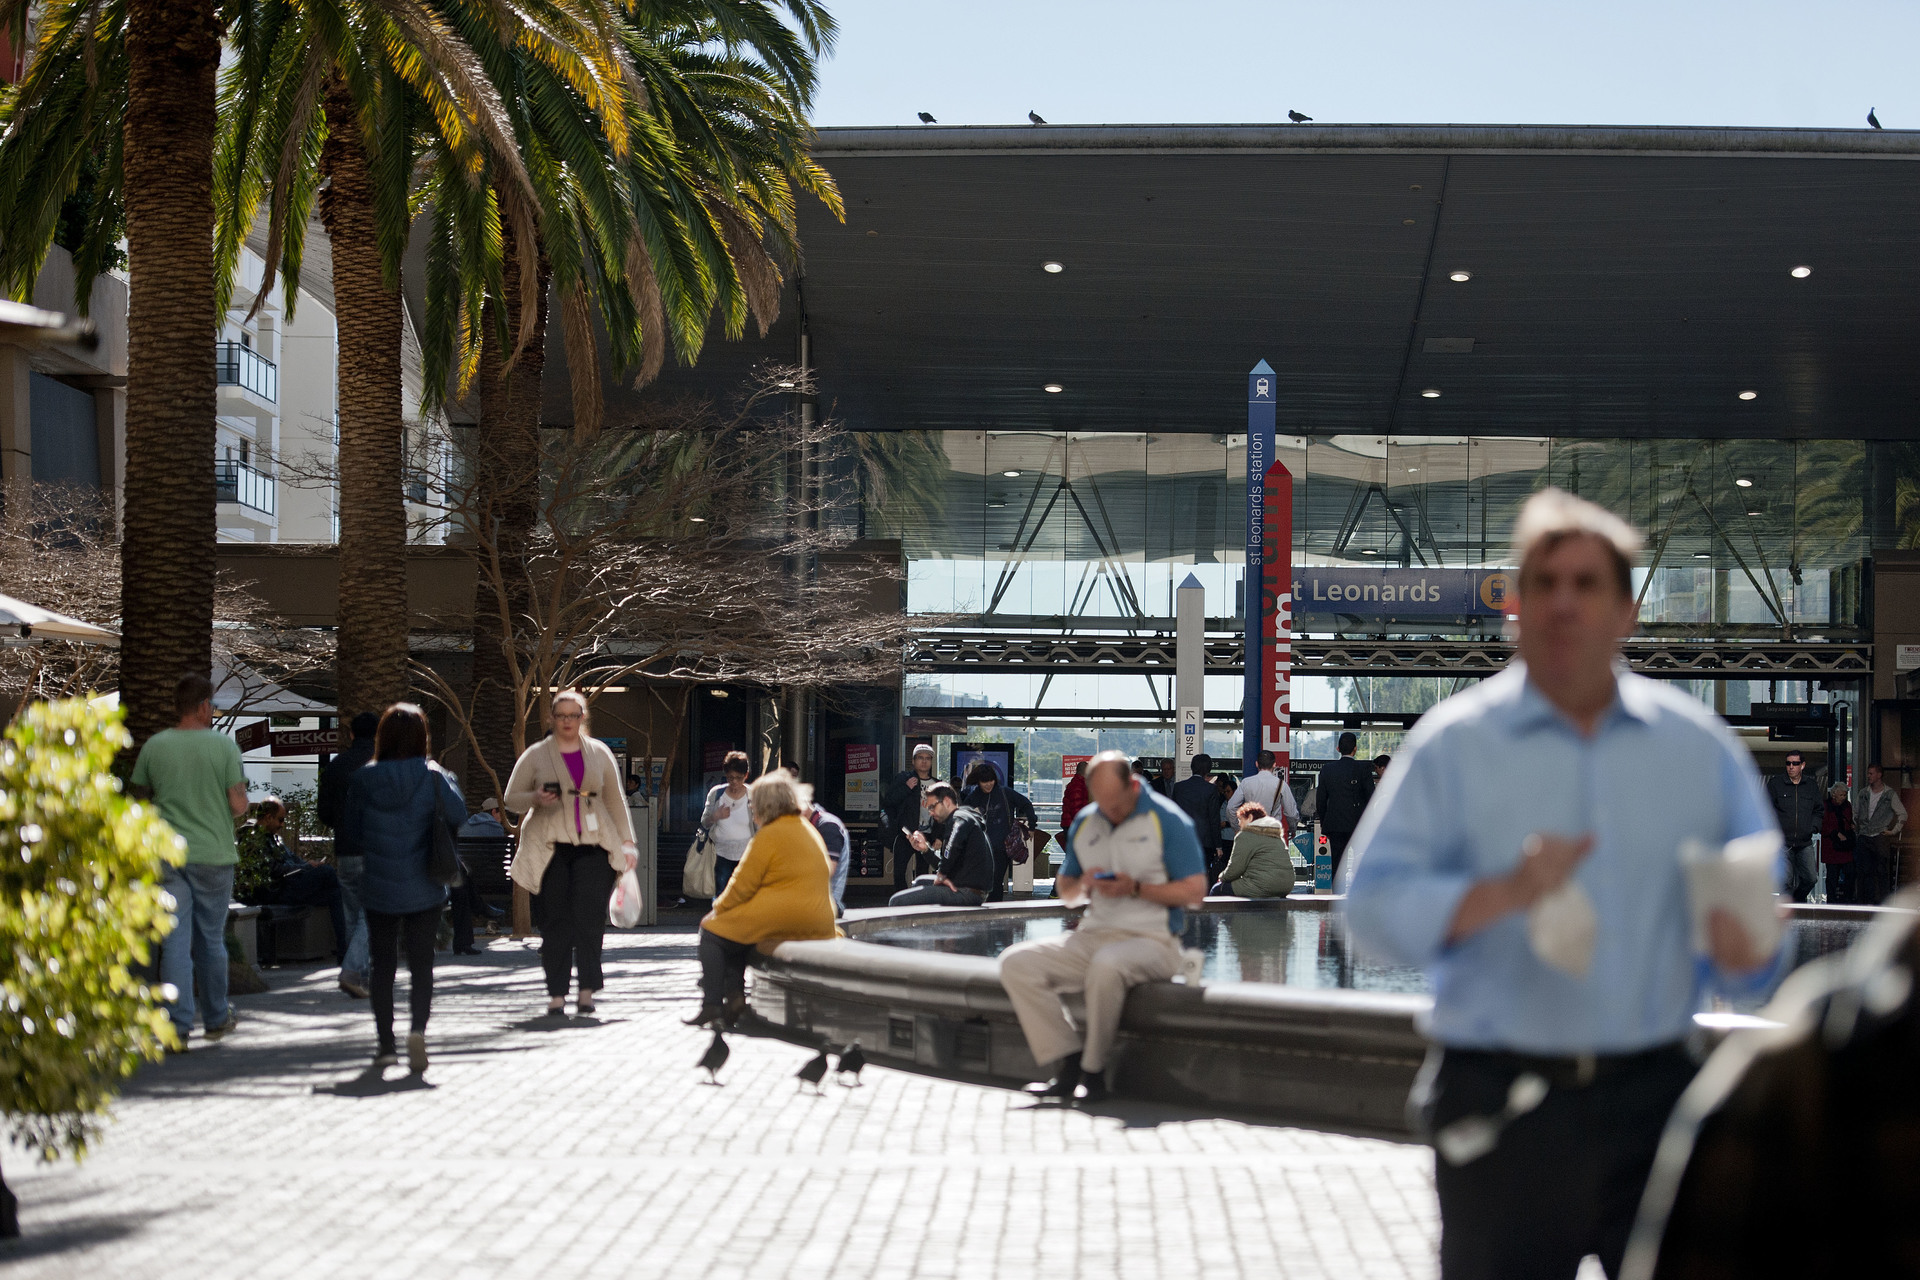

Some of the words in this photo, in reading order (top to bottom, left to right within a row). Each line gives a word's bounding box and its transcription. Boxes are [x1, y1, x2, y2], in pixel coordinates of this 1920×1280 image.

[1249, 432, 1263, 481] station
[1248, 486, 1262, 547] leonards
[1249, 551, 1261, 566] st
[1291, 580, 1302, 601] t
[1313, 578, 1441, 602] Leonards
[1185, 735, 1194, 756] RNS
[1290, 761, 1308, 769] Plan
[1294, 837, 1310, 846] only
[1316, 872, 1332, 880] only
